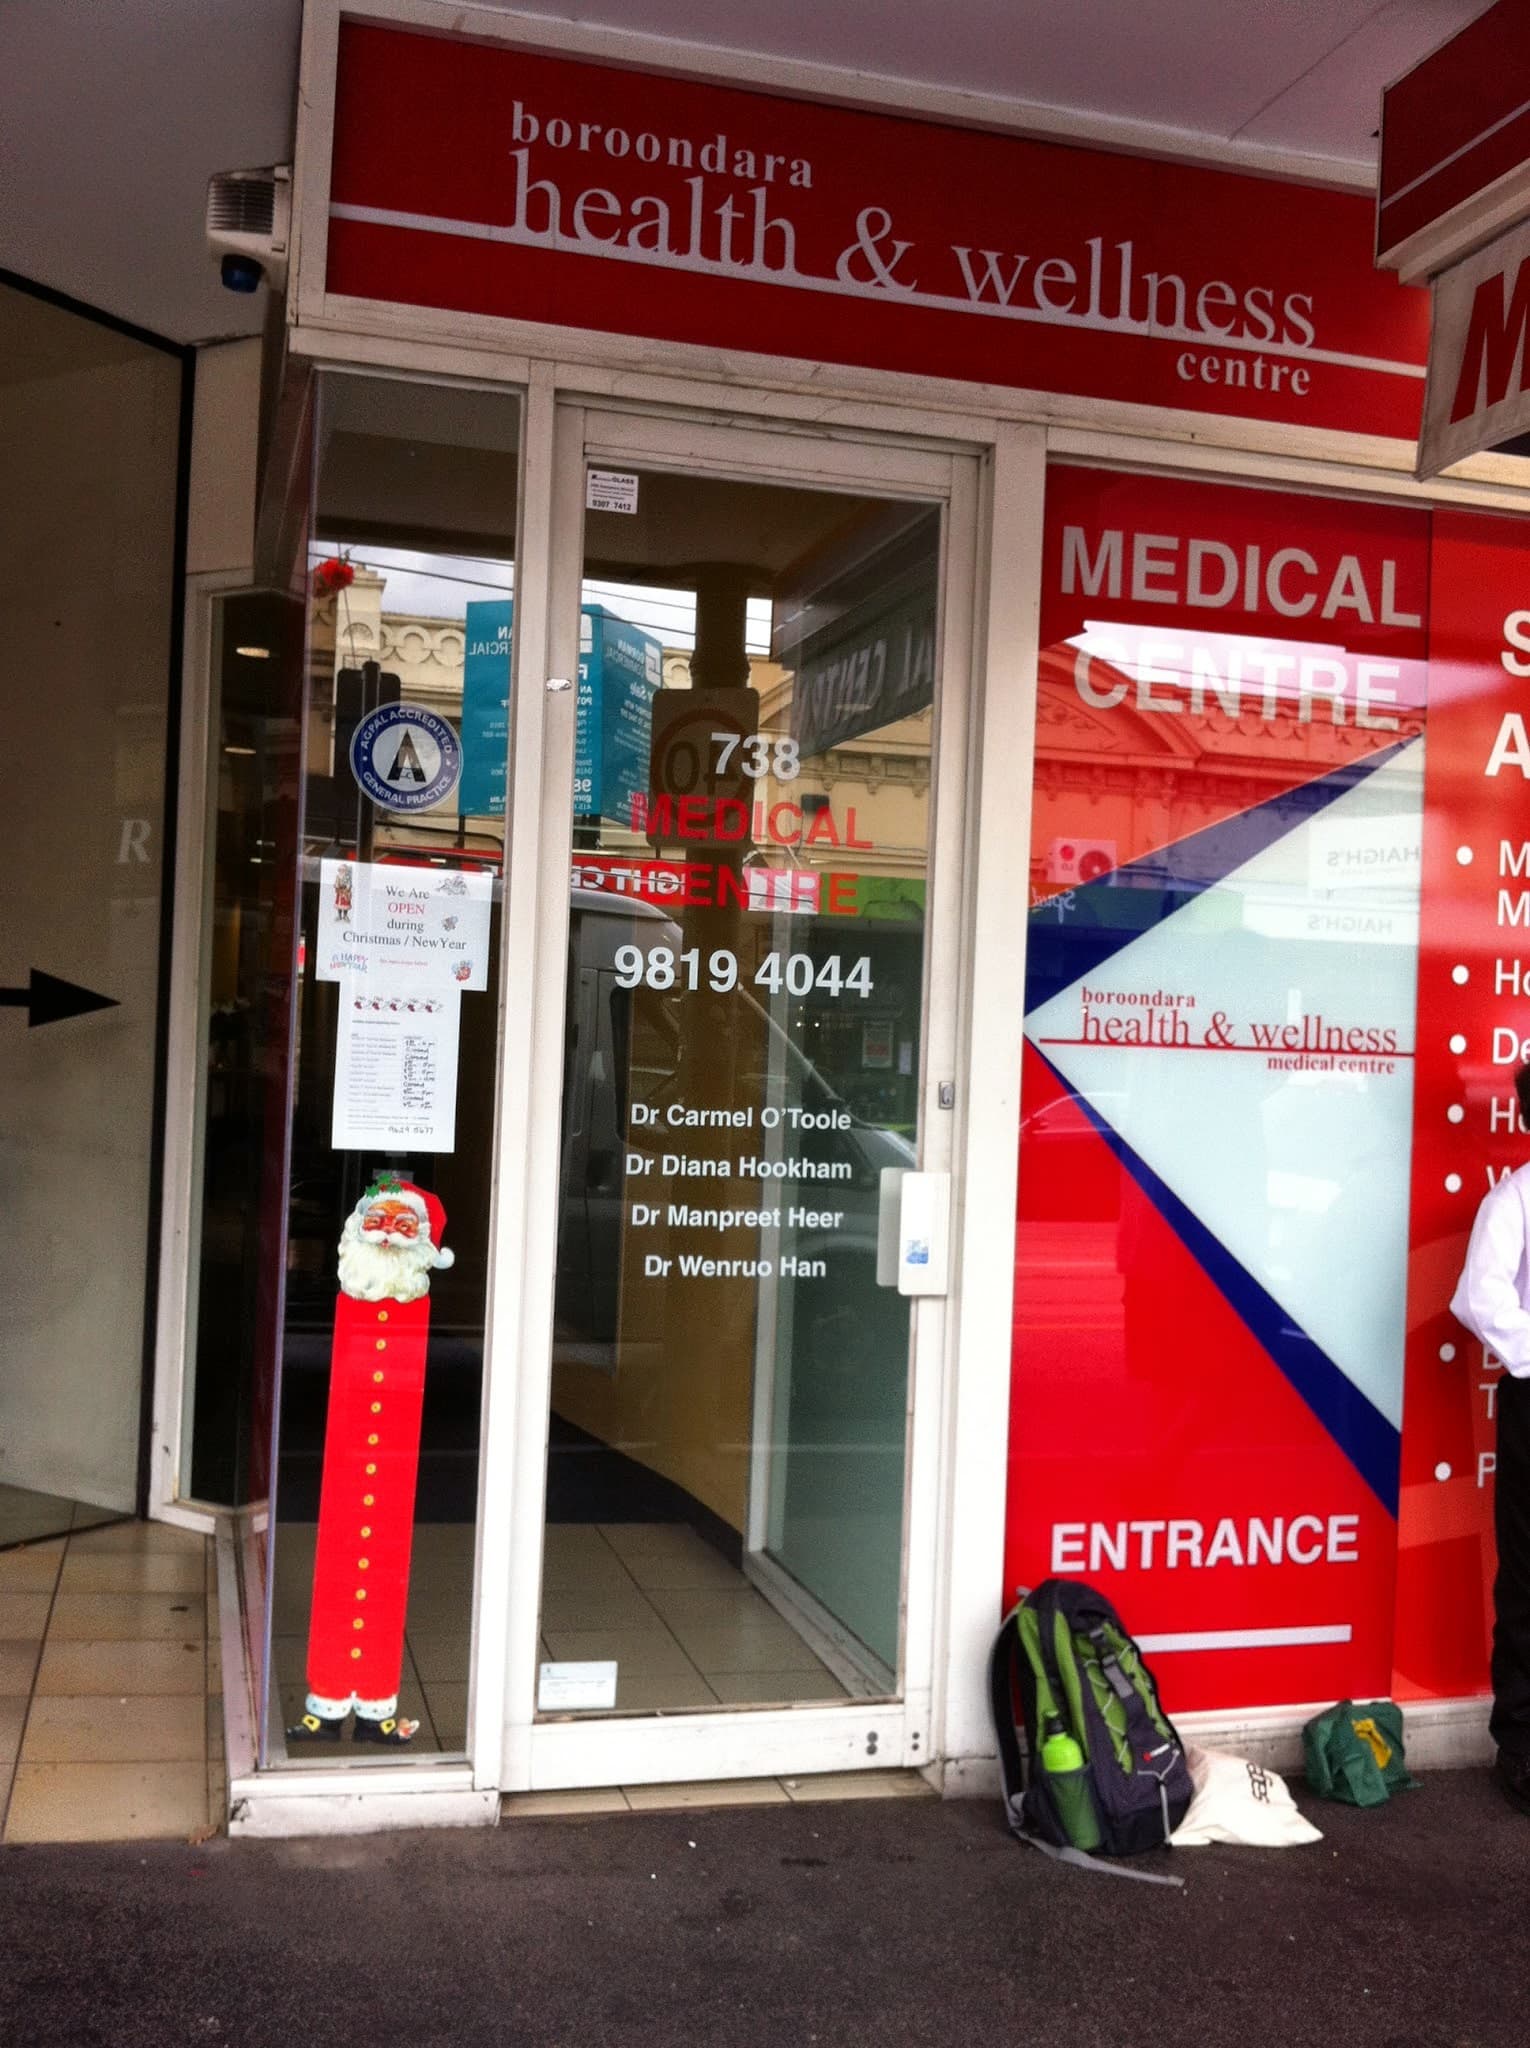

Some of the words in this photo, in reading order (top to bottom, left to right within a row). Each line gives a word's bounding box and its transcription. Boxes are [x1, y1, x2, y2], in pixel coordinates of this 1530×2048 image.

[512, 100, 814, 188] boroondara
[509, 148, 802, 275] health
[834, 206, 918, 294] &
[951, 237, 1317, 350] wellness
[1176, 352, 1311, 396] centre
[1061, 526, 1422, 628] MEDICAL
[1074, 645, 1402, 730] CENTRE
[361, 715, 390, 750] AGPAL
[389, 709, 453, 754] ACCREDITED
[711, 731, 801, 781] 738
[363, 771, 405, 804] GENERAL
[406, 775, 453, 806] PRACTICE
[630, 792, 873, 850] MEDICAL
[386, 885, 405, 898] We
[408, 887, 430, 900] Are
[388, 902, 425, 915] OPEN
[642, 861, 858, 915] CENTRE
[342, 930, 401, 946] Christmas
[404, 935, 409, 947] /
[412, 935, 438, 949] New
[439, 937, 467, 950] Year
[387, 918, 424, 934] during
[614, 944, 738, 993] 9819
[754, 952, 874, 999] 4044
[1082, 987, 1196, 1008] boroondara
[1081, 1006, 1191, 1045] health
[1203, 1011, 1236, 1047] &
[1249, 1015, 1397, 1052] wellness
[1267, 1055, 1335, 1072] medical
[1338, 1058, 1395, 1074] centre
[631, 1103, 660, 1125] Dr
[667, 1104, 752, 1128] Carmel
[761, 1107, 851, 1130] O'Toole
[626, 1154, 654, 1175] Dr
[662, 1155, 731, 1177] Diana
[739, 1156, 852, 1179] Hookham
[632, 1204, 660, 1226] Dr
[668, 1204, 781, 1232] Manpreet
[788, 1207, 844, 1228] Heer
[644, 1255, 672, 1277] Dr
[679, 1255, 772, 1277] Wenruo
[780, 1256, 827, 1277] Han
[1051, 1515, 1359, 1573] ENTRANCE
